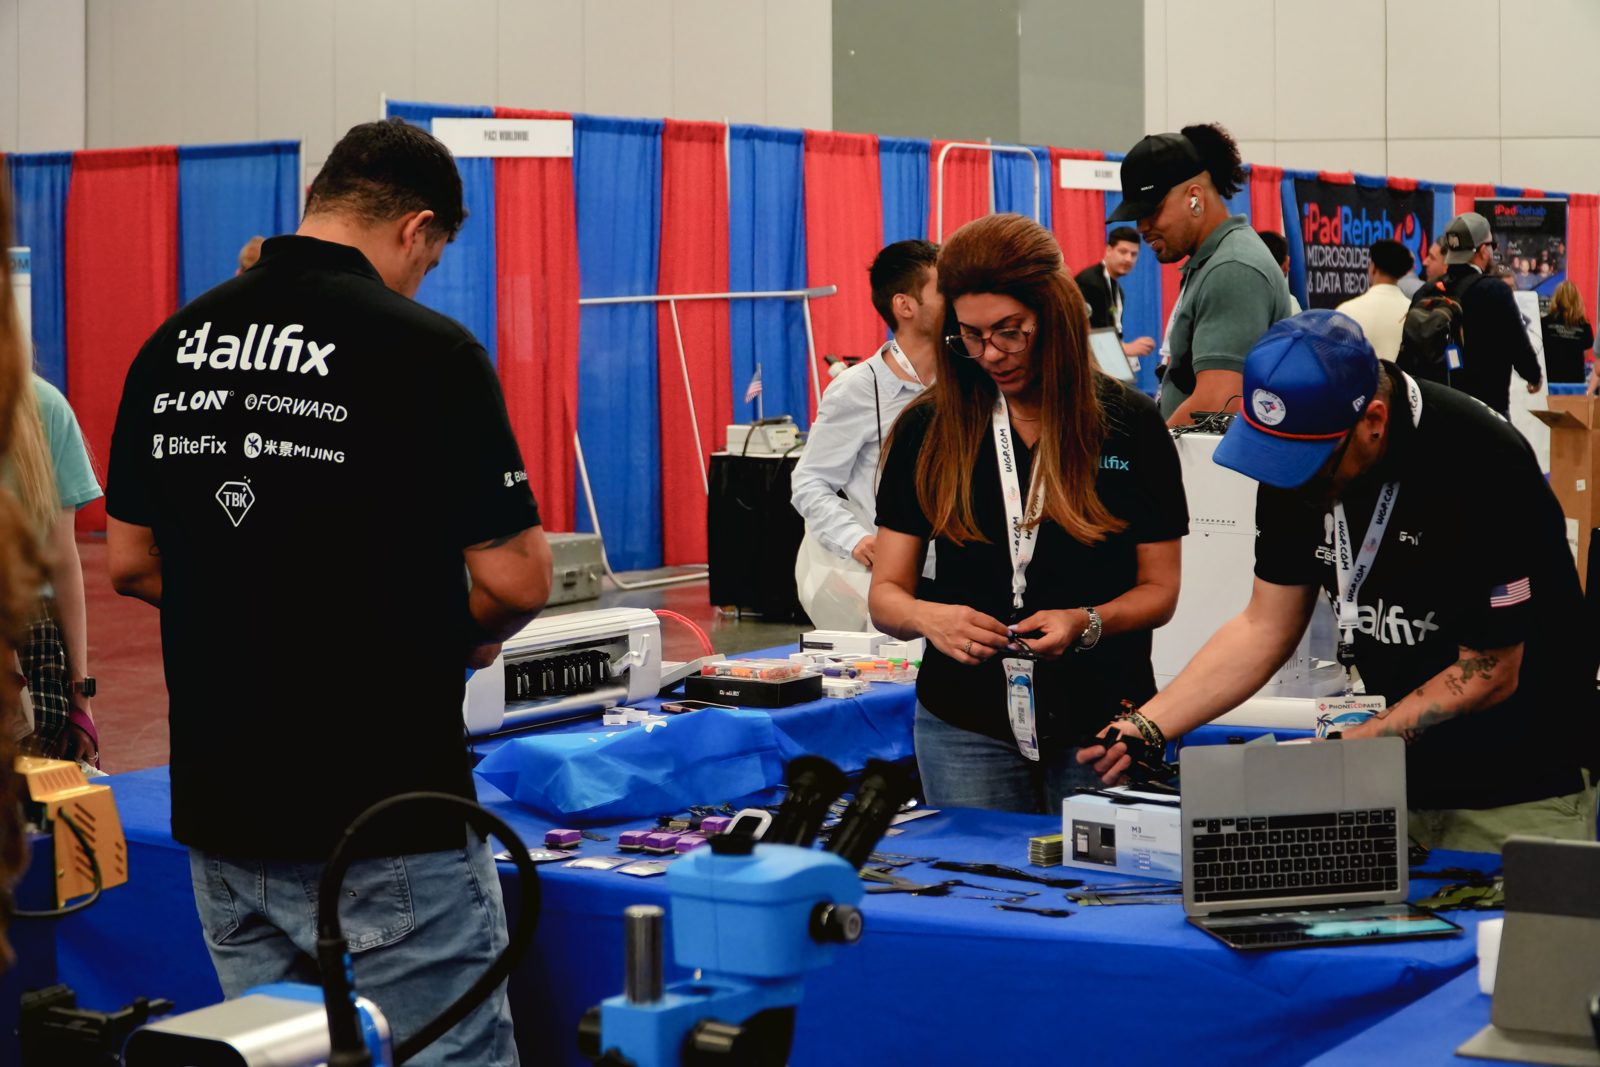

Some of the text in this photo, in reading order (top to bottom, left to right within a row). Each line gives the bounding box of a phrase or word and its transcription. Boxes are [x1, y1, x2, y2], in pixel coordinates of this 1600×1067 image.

[1316, 271, 1341, 293] DATA
[176, 321, 336, 376] 4allfix
[257, 394, 348, 422] FORWARD
[168, 435, 227, 455] BiteFix
[293, 444, 346, 463] MIJING
[223, 491, 247, 508] TBK
[1131, 826, 1142, 834] M3
